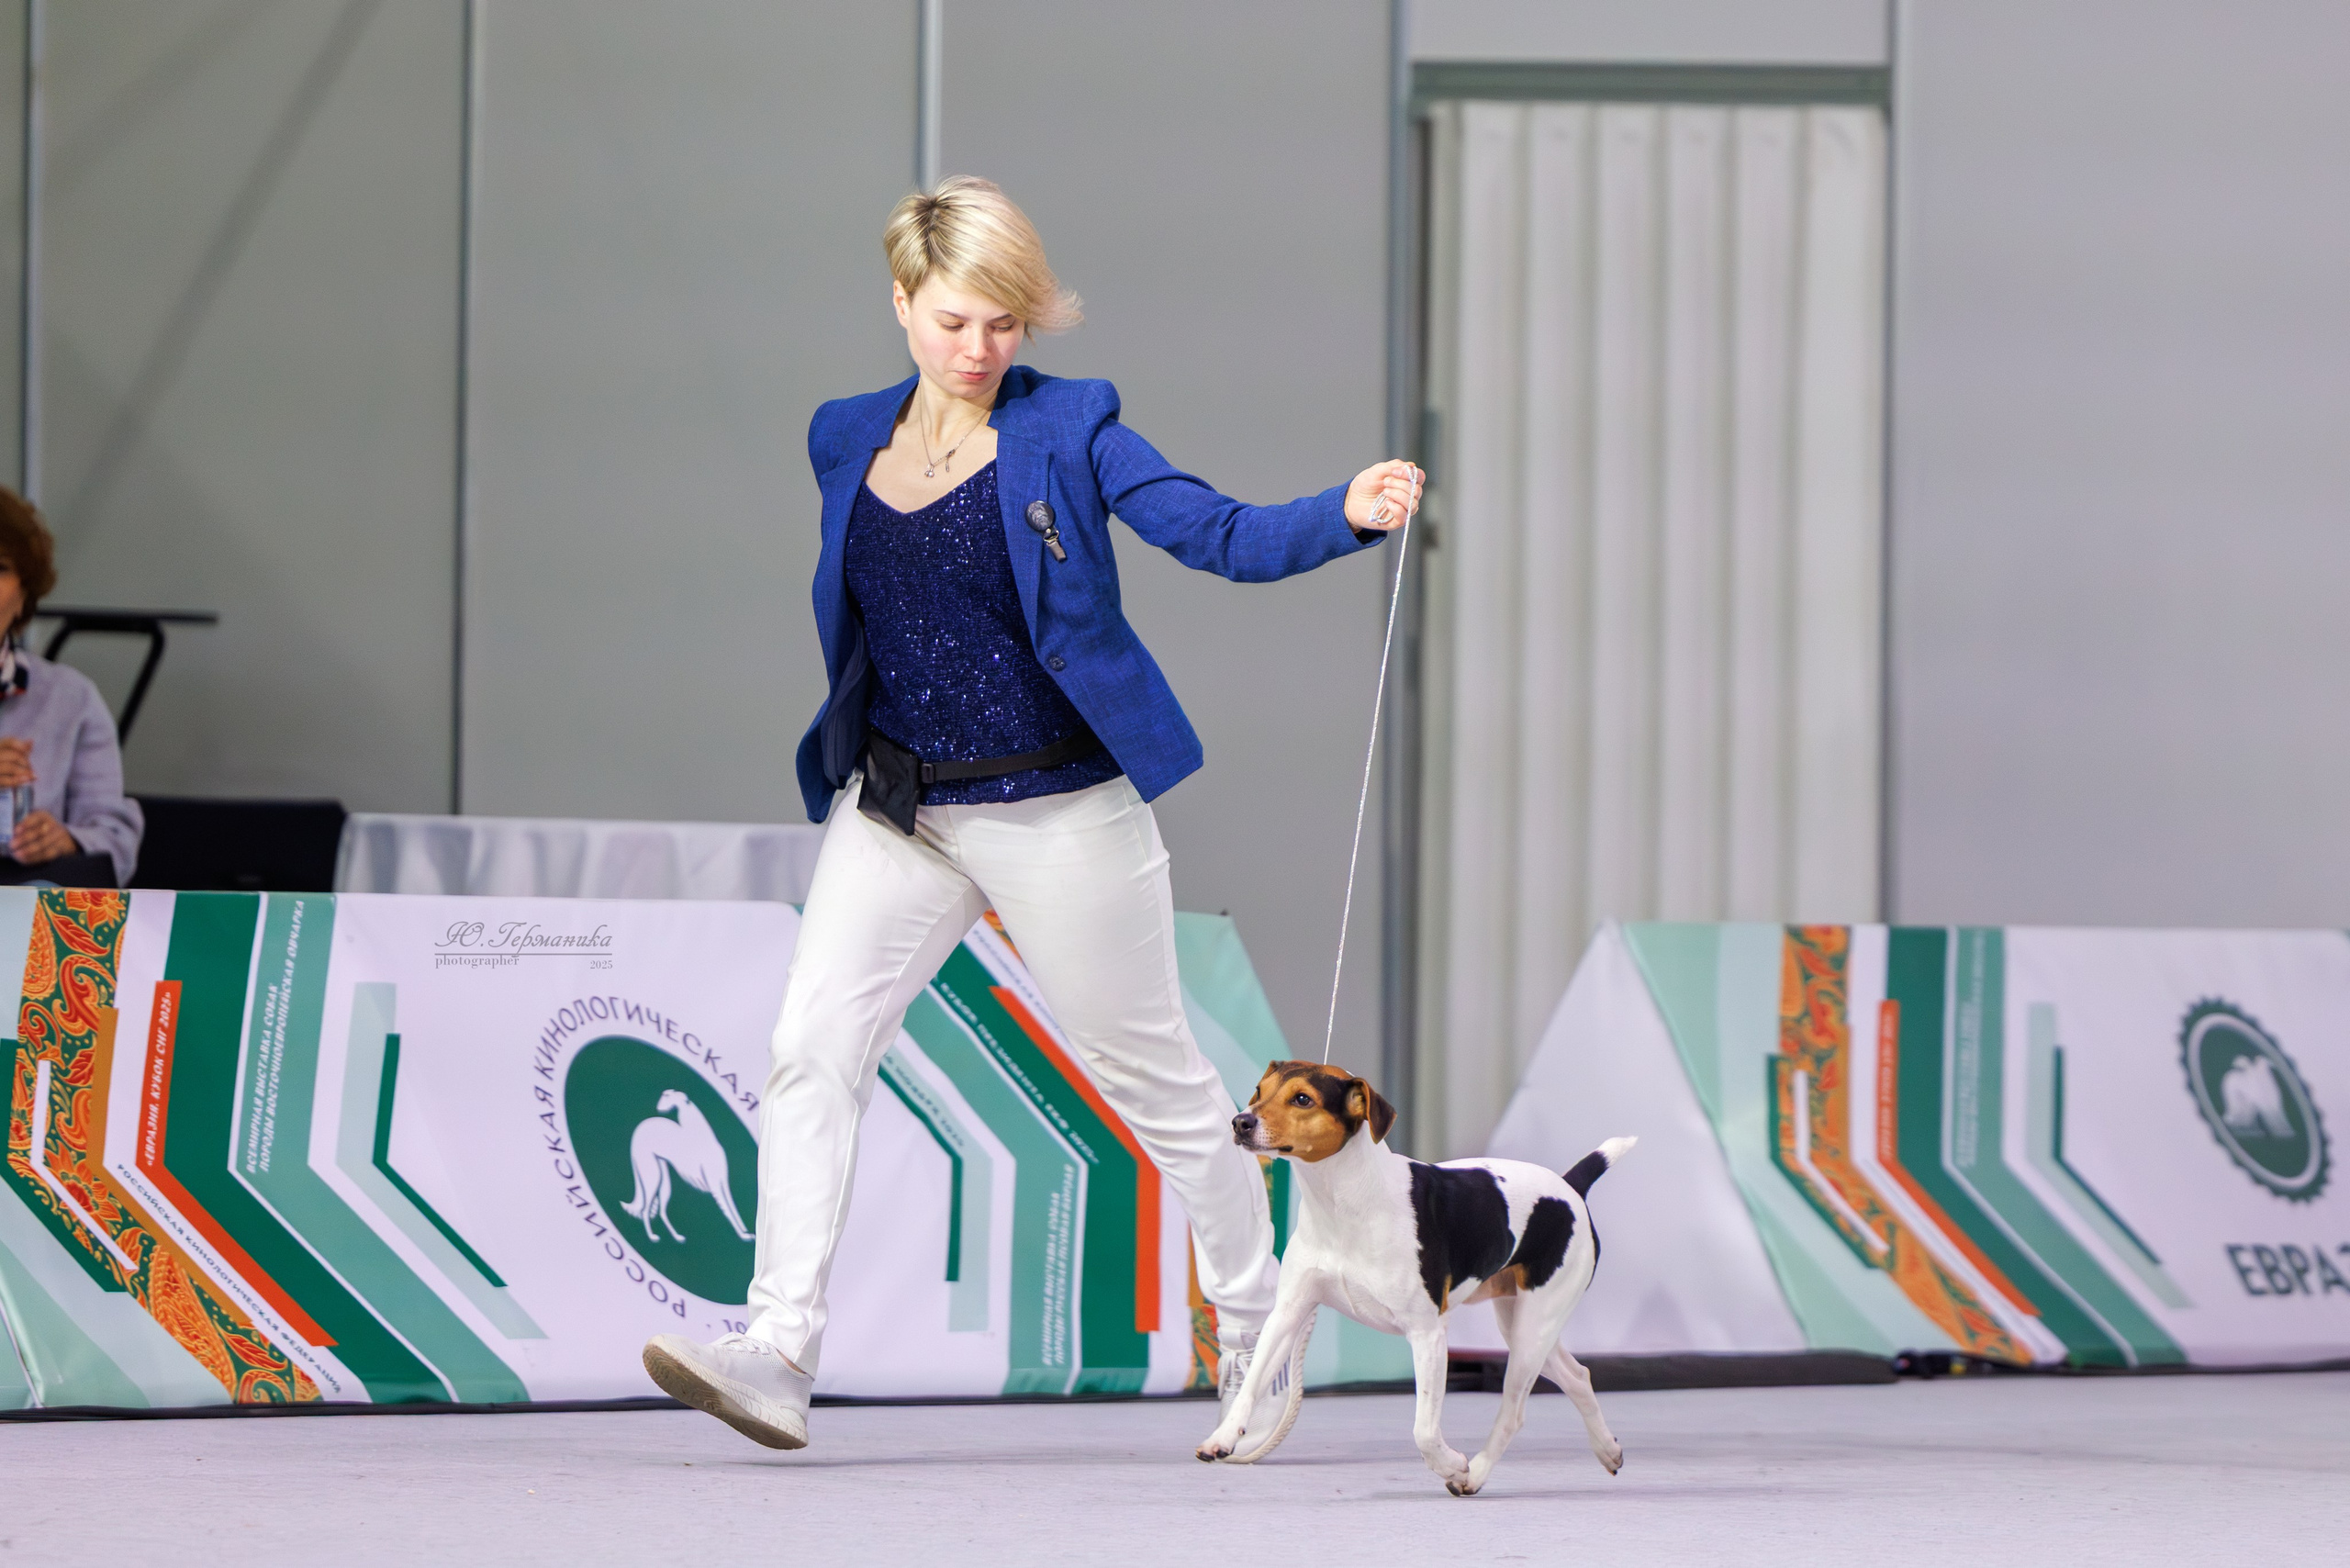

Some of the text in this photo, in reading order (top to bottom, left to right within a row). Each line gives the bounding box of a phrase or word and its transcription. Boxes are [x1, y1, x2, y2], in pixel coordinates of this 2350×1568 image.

[150, 1057, 164, 1099] КУБОК
[154, 1027, 167, 1054] СНГ
[246, 982, 277, 1173] ВСЕМИРНАЯ ВЫСТАВКА СОБАК
[533, 995, 760, 1318] РОССИЙСКАЯ КИНОЛОГИЧЕСКАЯ
[116, 1162, 343, 1394] РОССИЙСКАЯ КИНОЛОГИЧЕСКАЯ ФЕДЕРАЦИЯ
[2225, 1243, 2350, 1296] ЕВРА
